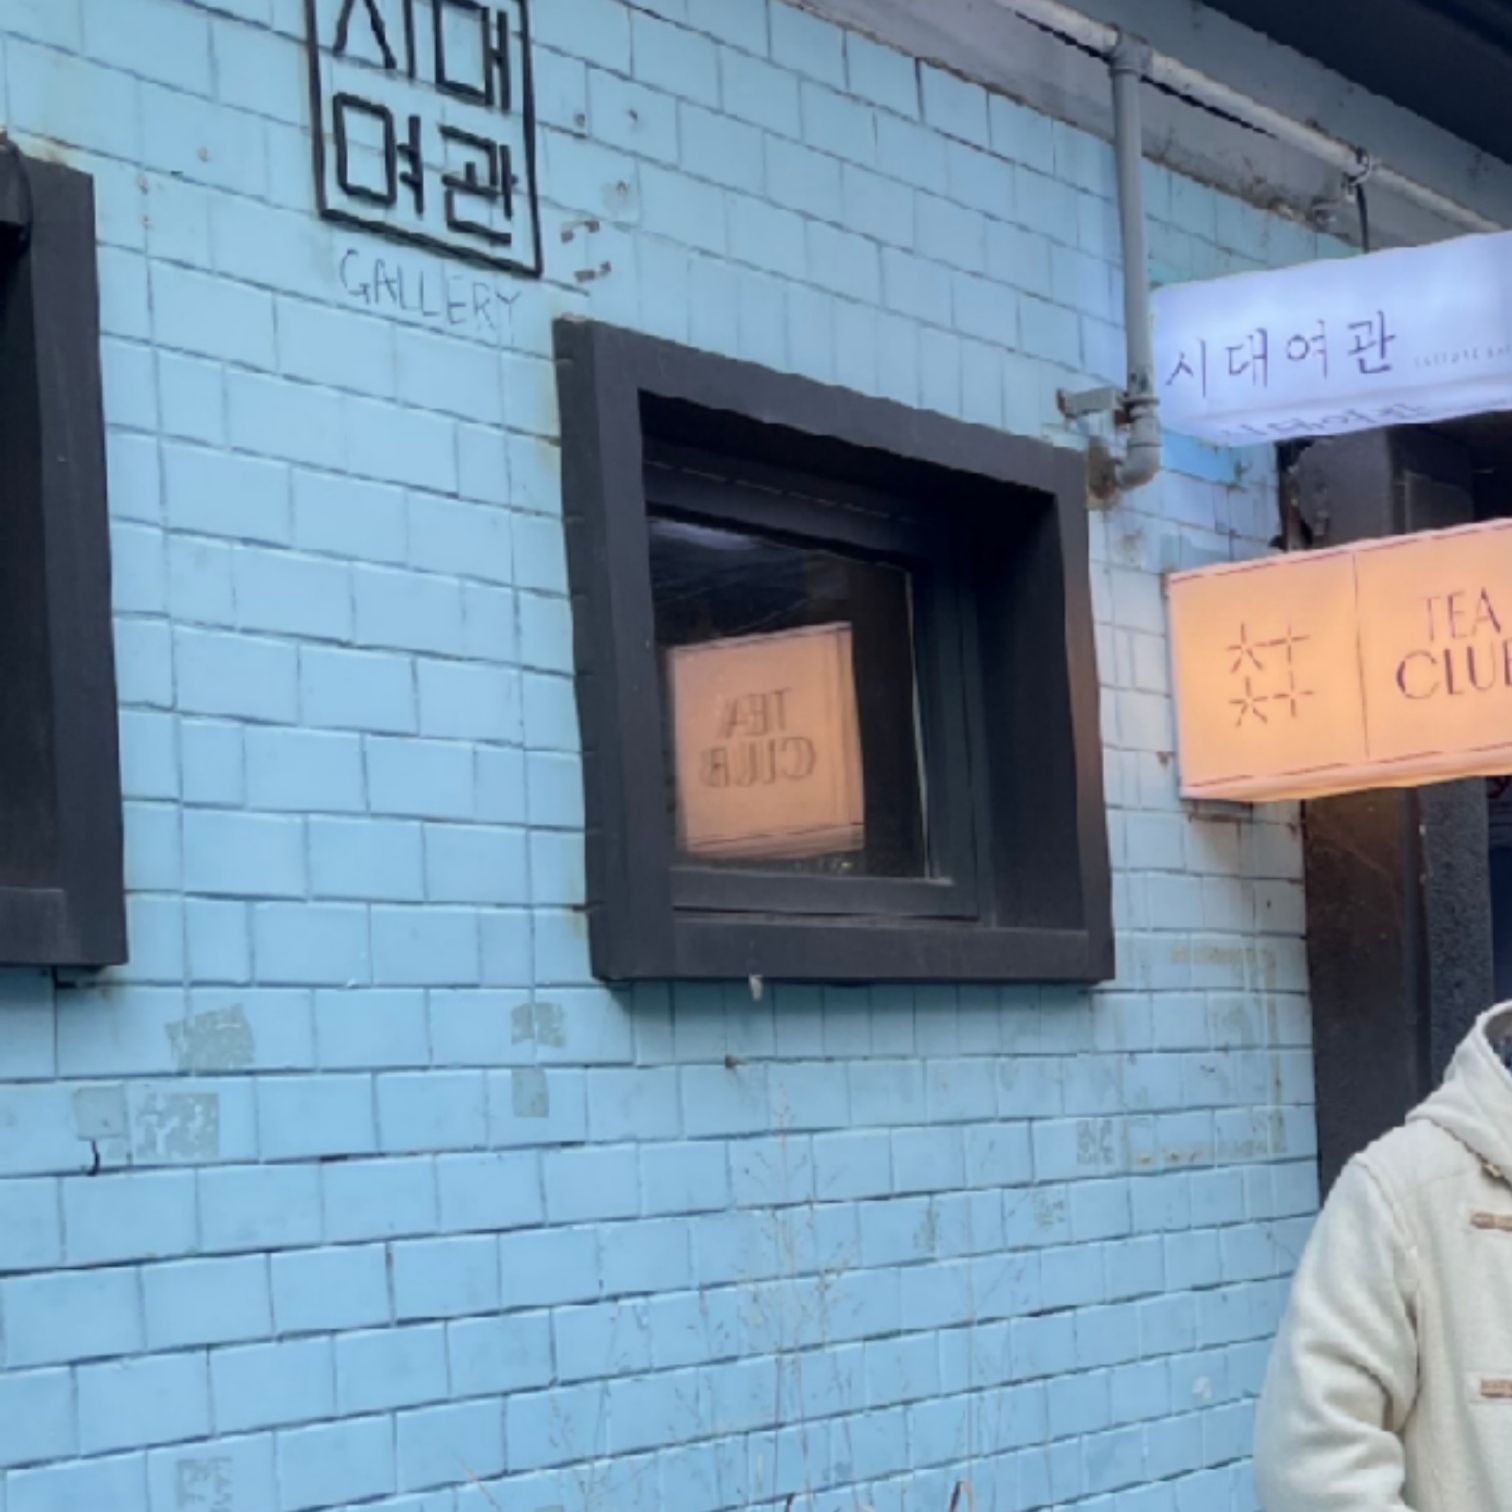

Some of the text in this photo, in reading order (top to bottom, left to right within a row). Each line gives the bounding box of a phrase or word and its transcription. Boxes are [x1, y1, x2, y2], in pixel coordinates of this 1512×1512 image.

[333, 92, 519, 247] 여관
[339, 248, 522, 333] GALLERY
[1166, 310, 1397, 398] 시대여관
[1423, 588, 1502, 642] TEA
